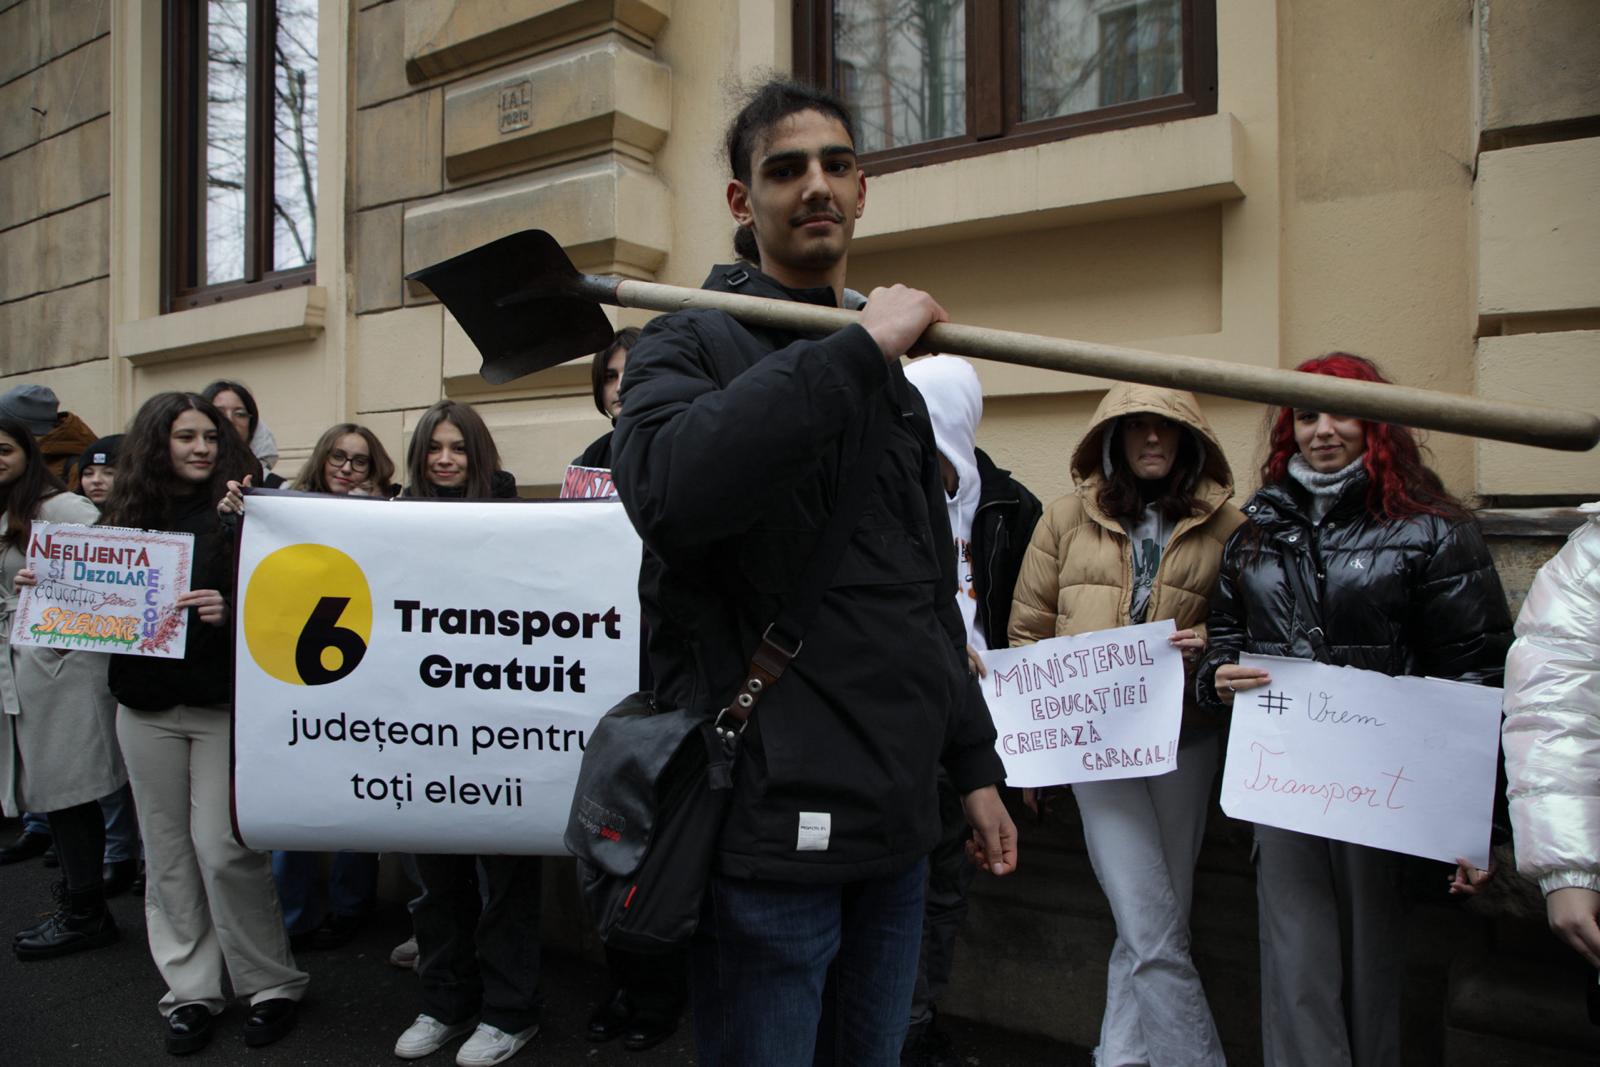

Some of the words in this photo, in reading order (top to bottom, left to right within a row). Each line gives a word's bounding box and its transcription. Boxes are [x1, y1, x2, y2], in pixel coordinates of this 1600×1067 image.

[296, 597, 367, 685] 6
[394, 600, 620, 645] Transport
[420, 654, 586, 693] Gratuit
[994, 640, 1154, 697] MINISTERUL
[1031, 677, 1148, 720] EDUCAȚIEI
[289, 710, 458, 752] județean
[1003, 720, 1102, 755] CREEAZĂ
[351, 773, 413, 810] toți
[425, 775, 523, 807] elevii
[1244, 741, 1416, 815] Transport
